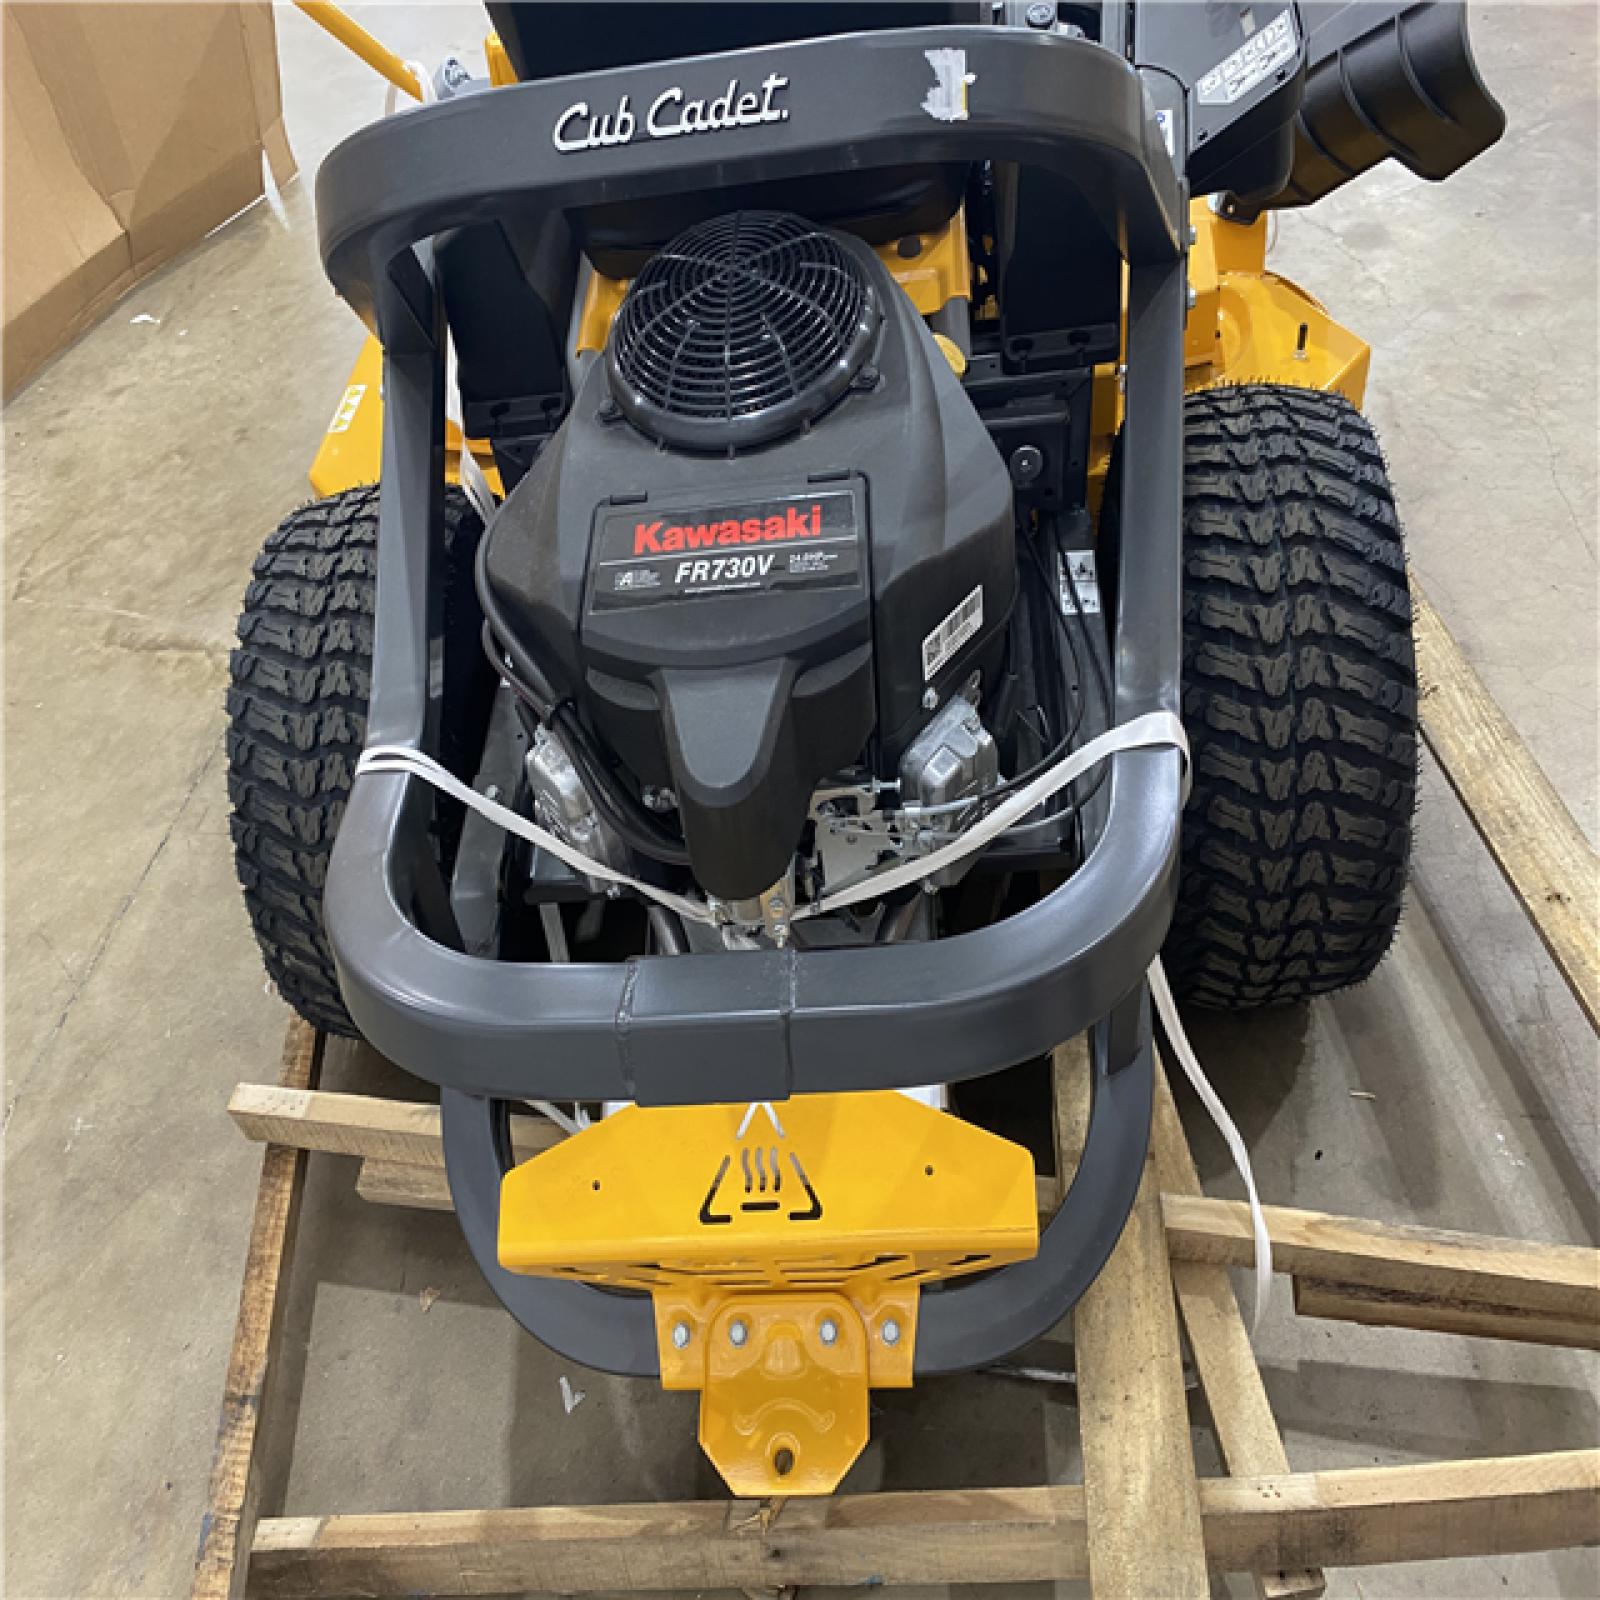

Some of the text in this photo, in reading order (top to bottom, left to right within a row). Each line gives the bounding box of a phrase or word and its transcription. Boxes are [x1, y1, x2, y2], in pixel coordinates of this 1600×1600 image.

[553, 94, 636, 152] Cub
[632, 504, 822, 556] Kawasaki
[674, 554, 776, 585] FR730V
